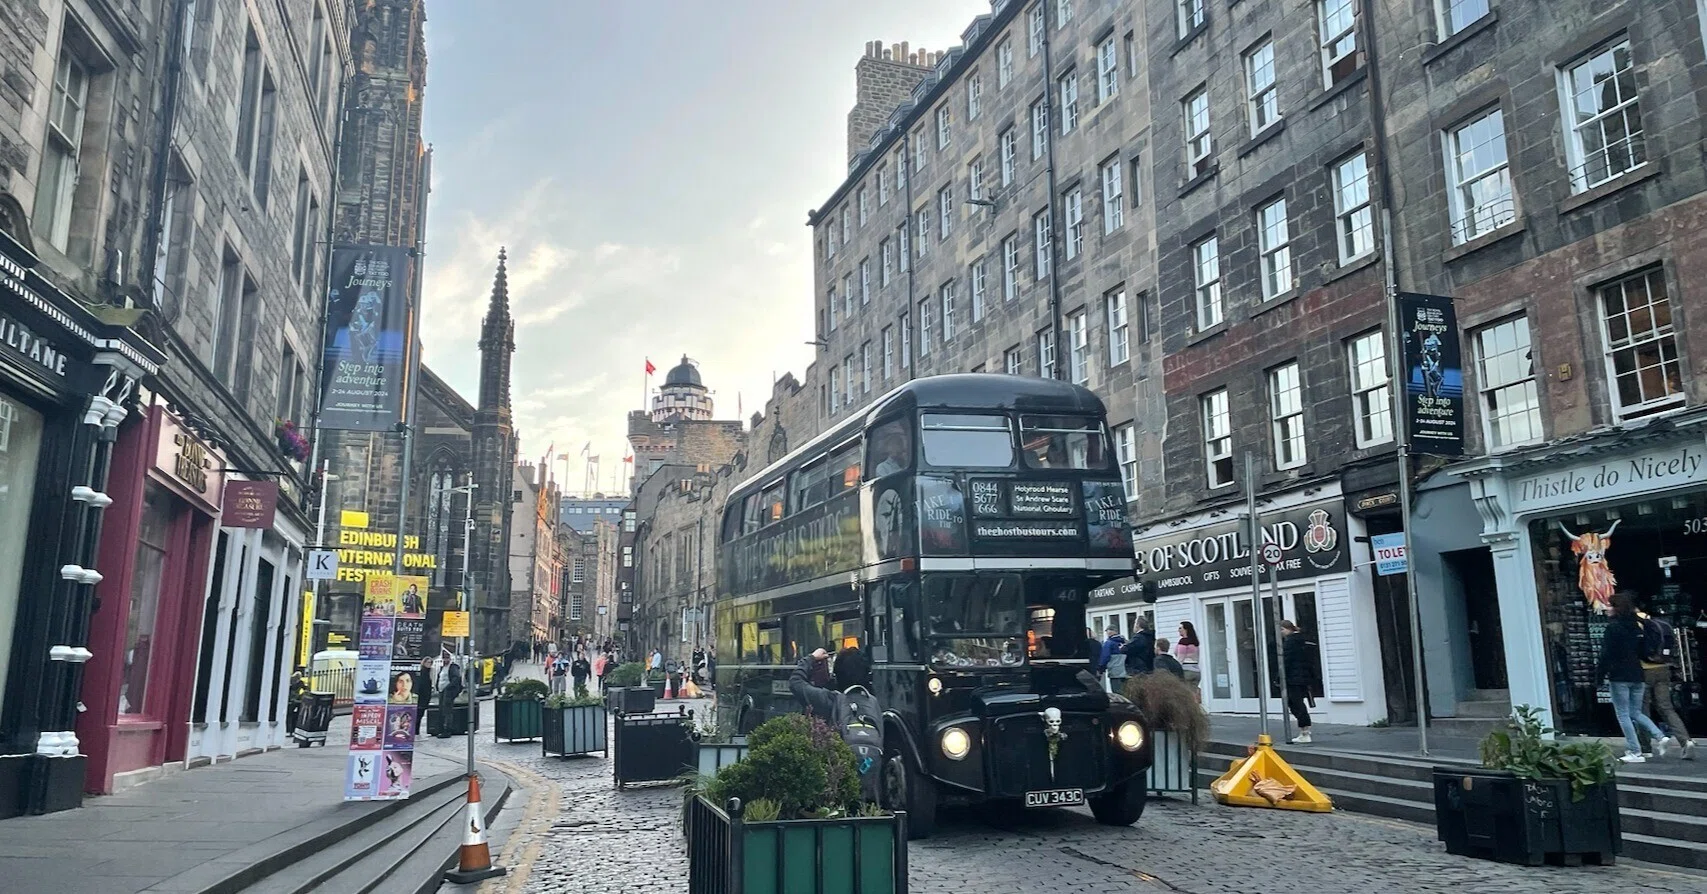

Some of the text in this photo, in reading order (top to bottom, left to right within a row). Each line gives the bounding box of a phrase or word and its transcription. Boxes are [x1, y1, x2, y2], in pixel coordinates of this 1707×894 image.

[344, 275, 393, 291] Journeys
[1412, 320, 1448, 335] Journeys
[0, 318, 67, 377] ILTANE
[338, 360, 385, 376] Step into
[335, 373, 387, 387] adventure
[1417, 393, 1451, 407] Step into
[1417, 405, 1455, 418] adventure
[1521, 449, 1702, 501] Thistle do Nicely
[972, 482, 998, 493] 0844
[1014, 485, 1046, 494] Holyrood
[974, 493, 998, 504] 5677
[1084, 495, 1116, 512] TAKE
[927, 509, 952, 520] RIDE
[978, 503, 998, 514] 666
[1100, 509, 1122, 521] RIDE
[1149, 545, 1174, 572] OF
[1178, 521, 1298, 569] SCOTLND
[337, 548, 437, 570] NTERNAONAL
[1264, 549, 1280, 559] 20
[1378, 549, 1392, 559] TO
[315, 554, 330, 570] K
[337, 567, 393, 582] FEST
[1094, 587, 1116, 598] TARTANS
[1121, 583, 1143, 594] CASHME
[1157, 575, 1193, 589] LAMBSWOOL
[1203, 571, 1220, 581] GIFTS
[1230, 564, 1266, 578] SOUVERS
[1275, 561, 1285, 571] AX
[1286, 558, 1302, 570] FREE
[1028, 791, 1081, 805] CUV 343C
